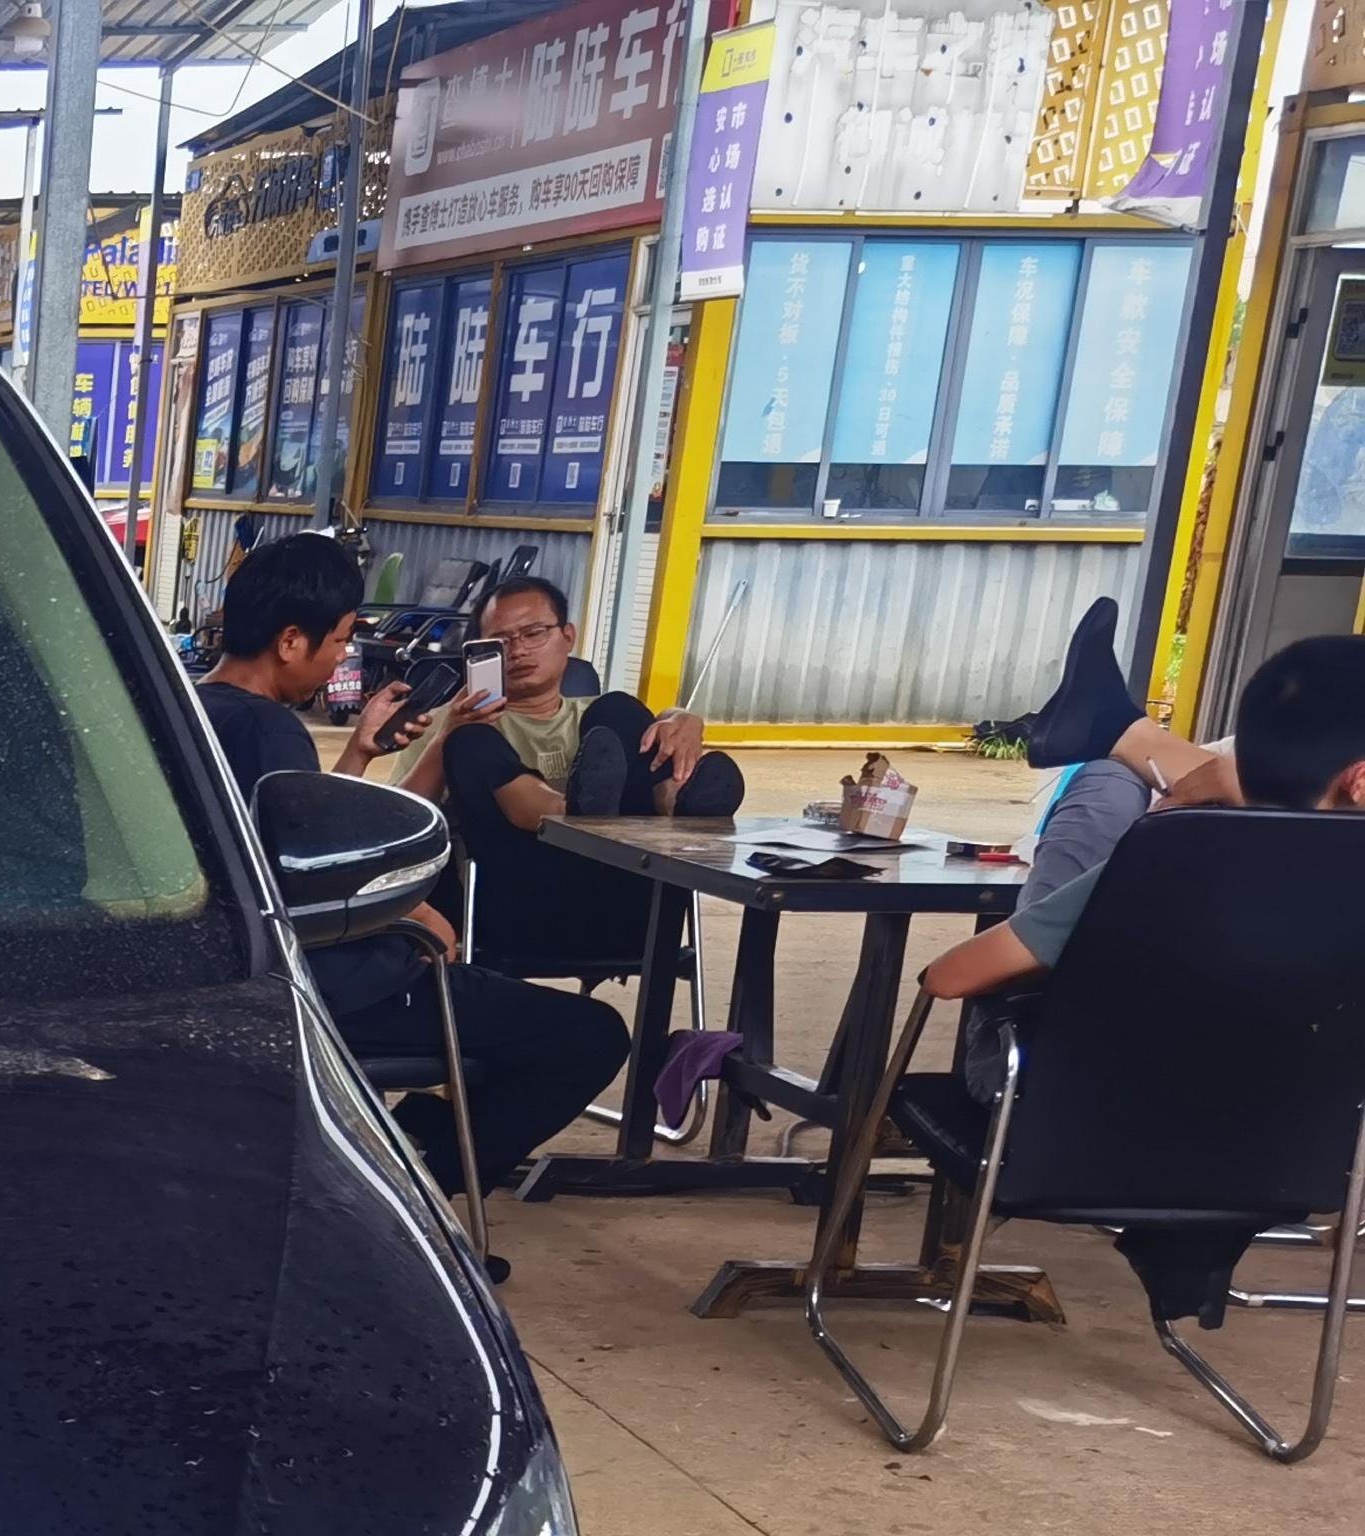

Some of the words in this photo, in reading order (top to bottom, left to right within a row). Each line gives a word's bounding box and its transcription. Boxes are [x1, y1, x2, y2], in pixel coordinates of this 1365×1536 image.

[695, 105, 728, 253] 安心选购
[712, 101, 748, 250] 市场认证
